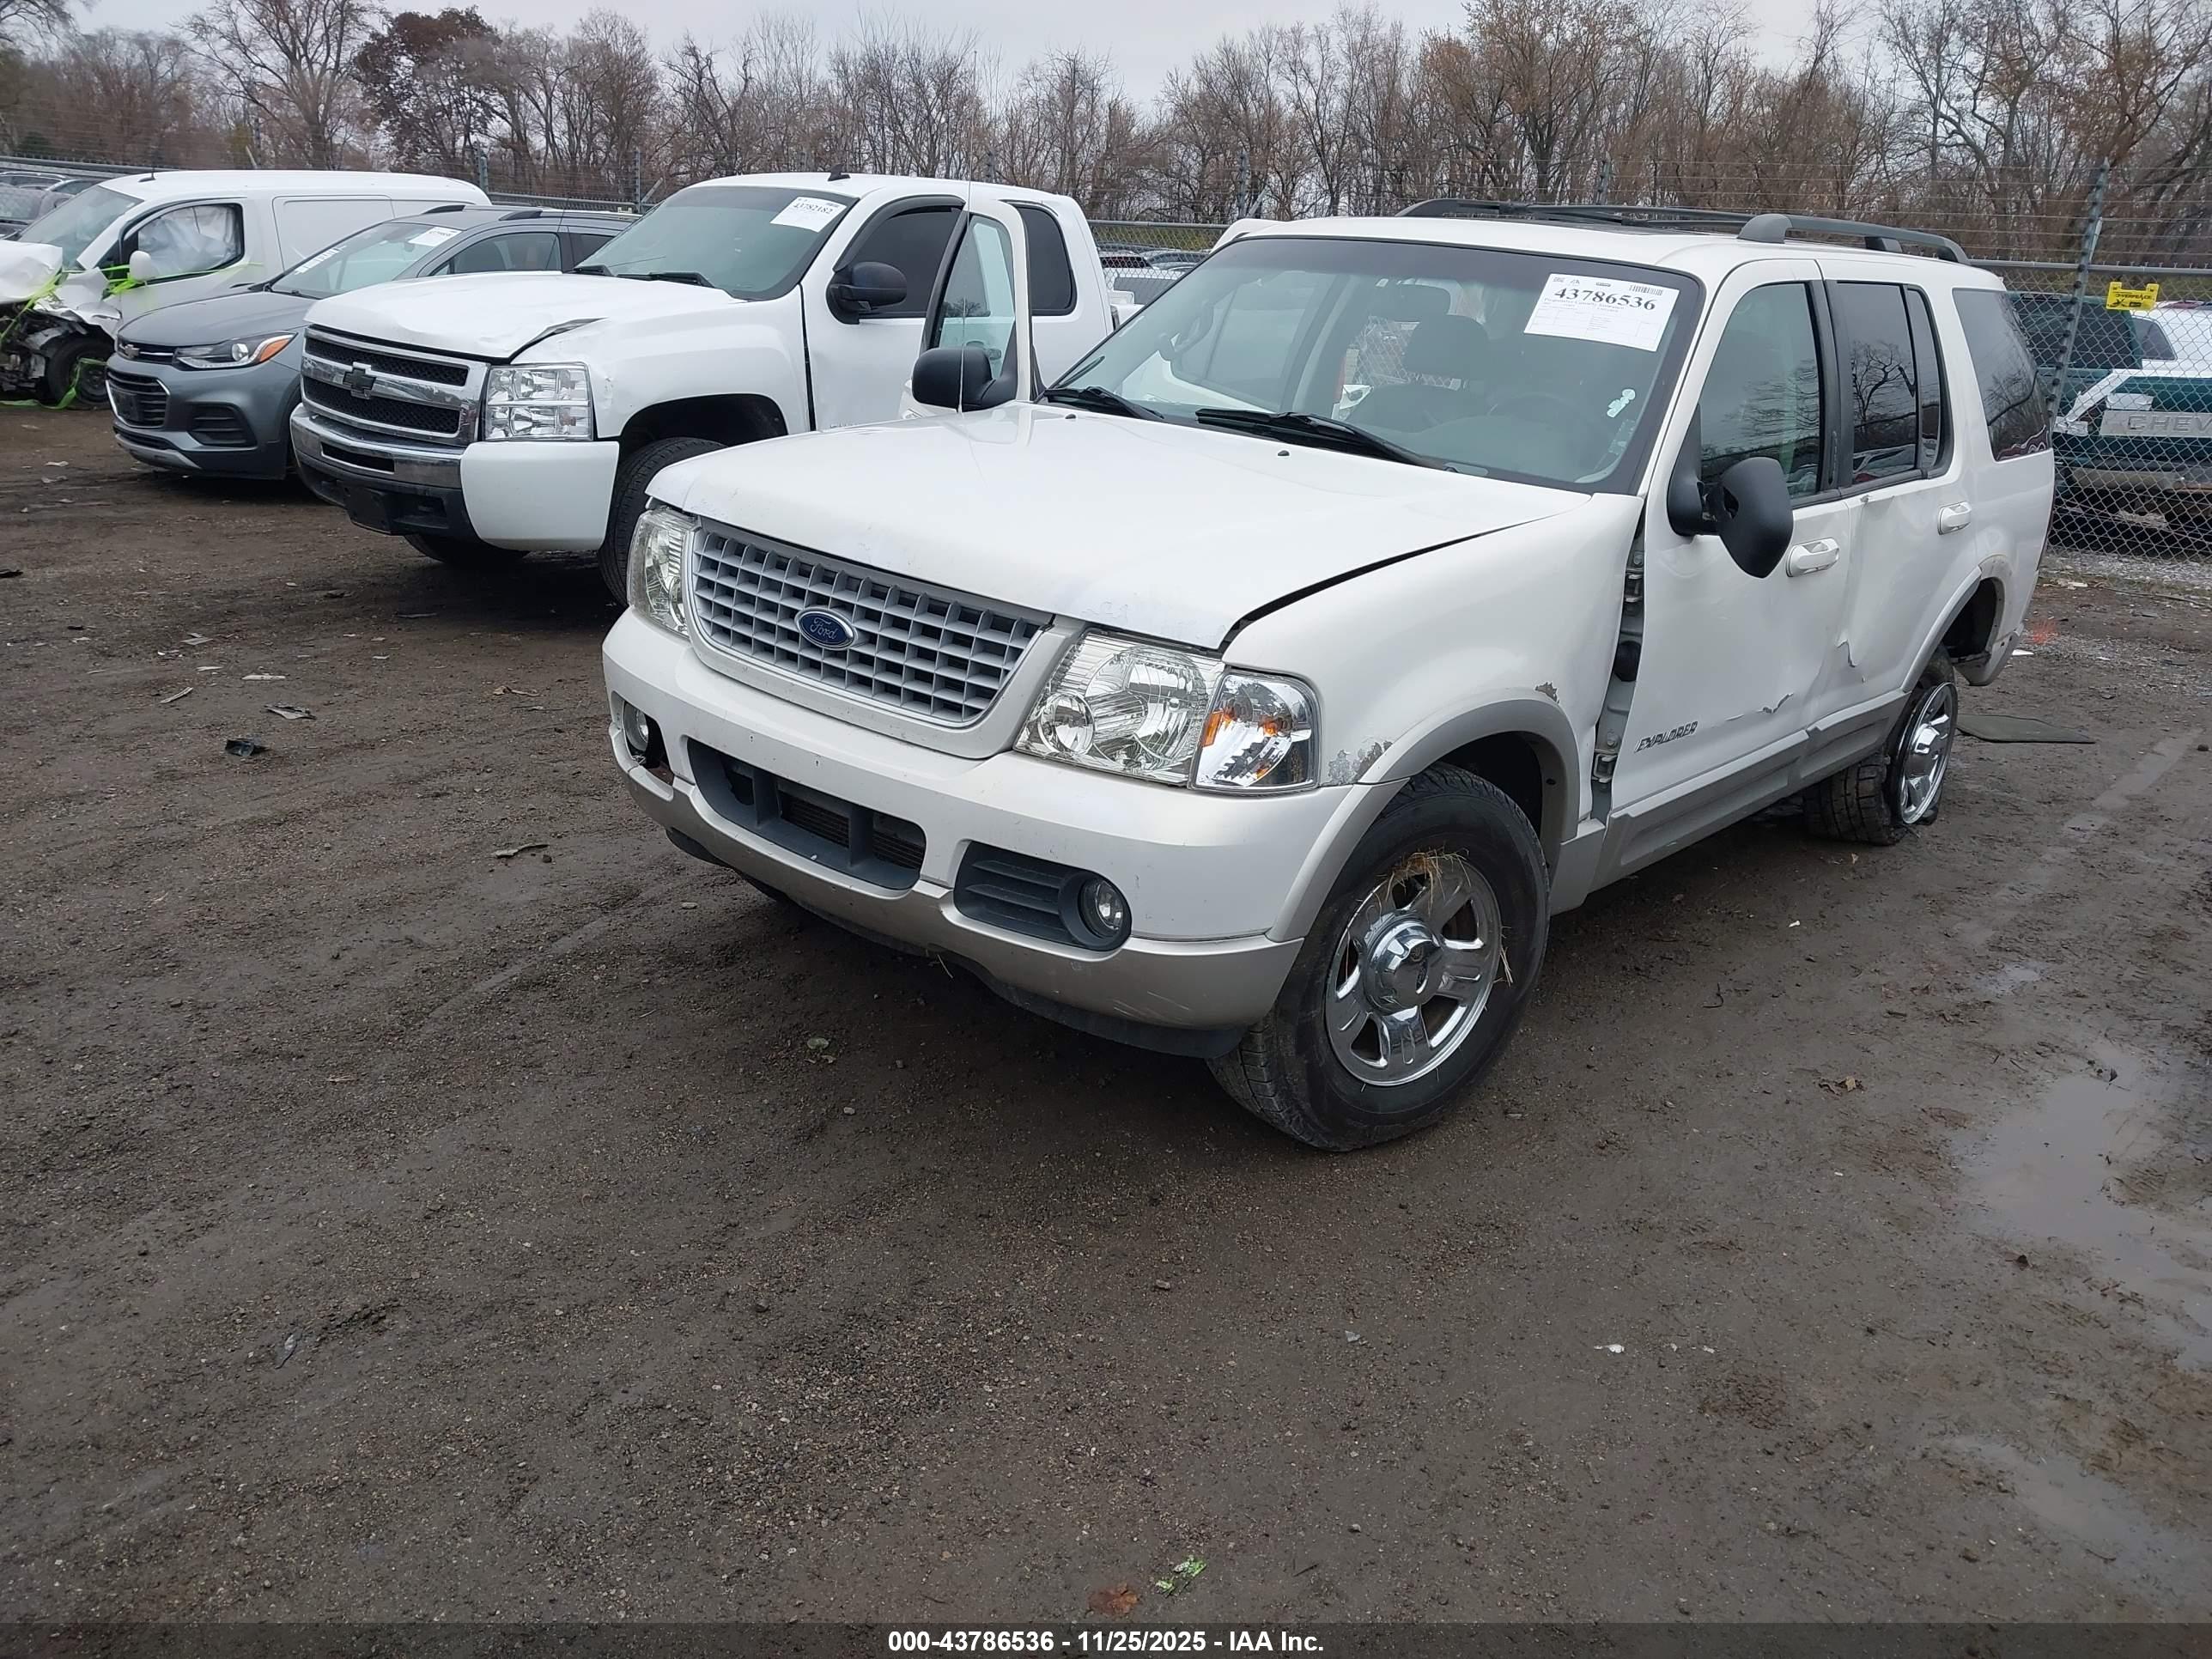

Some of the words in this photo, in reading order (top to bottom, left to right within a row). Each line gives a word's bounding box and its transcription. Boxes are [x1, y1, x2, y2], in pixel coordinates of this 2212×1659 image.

[1554, 288, 1658, 312] 43786536
[810, 617, 839, 640] Ford
[1634, 720, 1698, 753] EXPLORER
